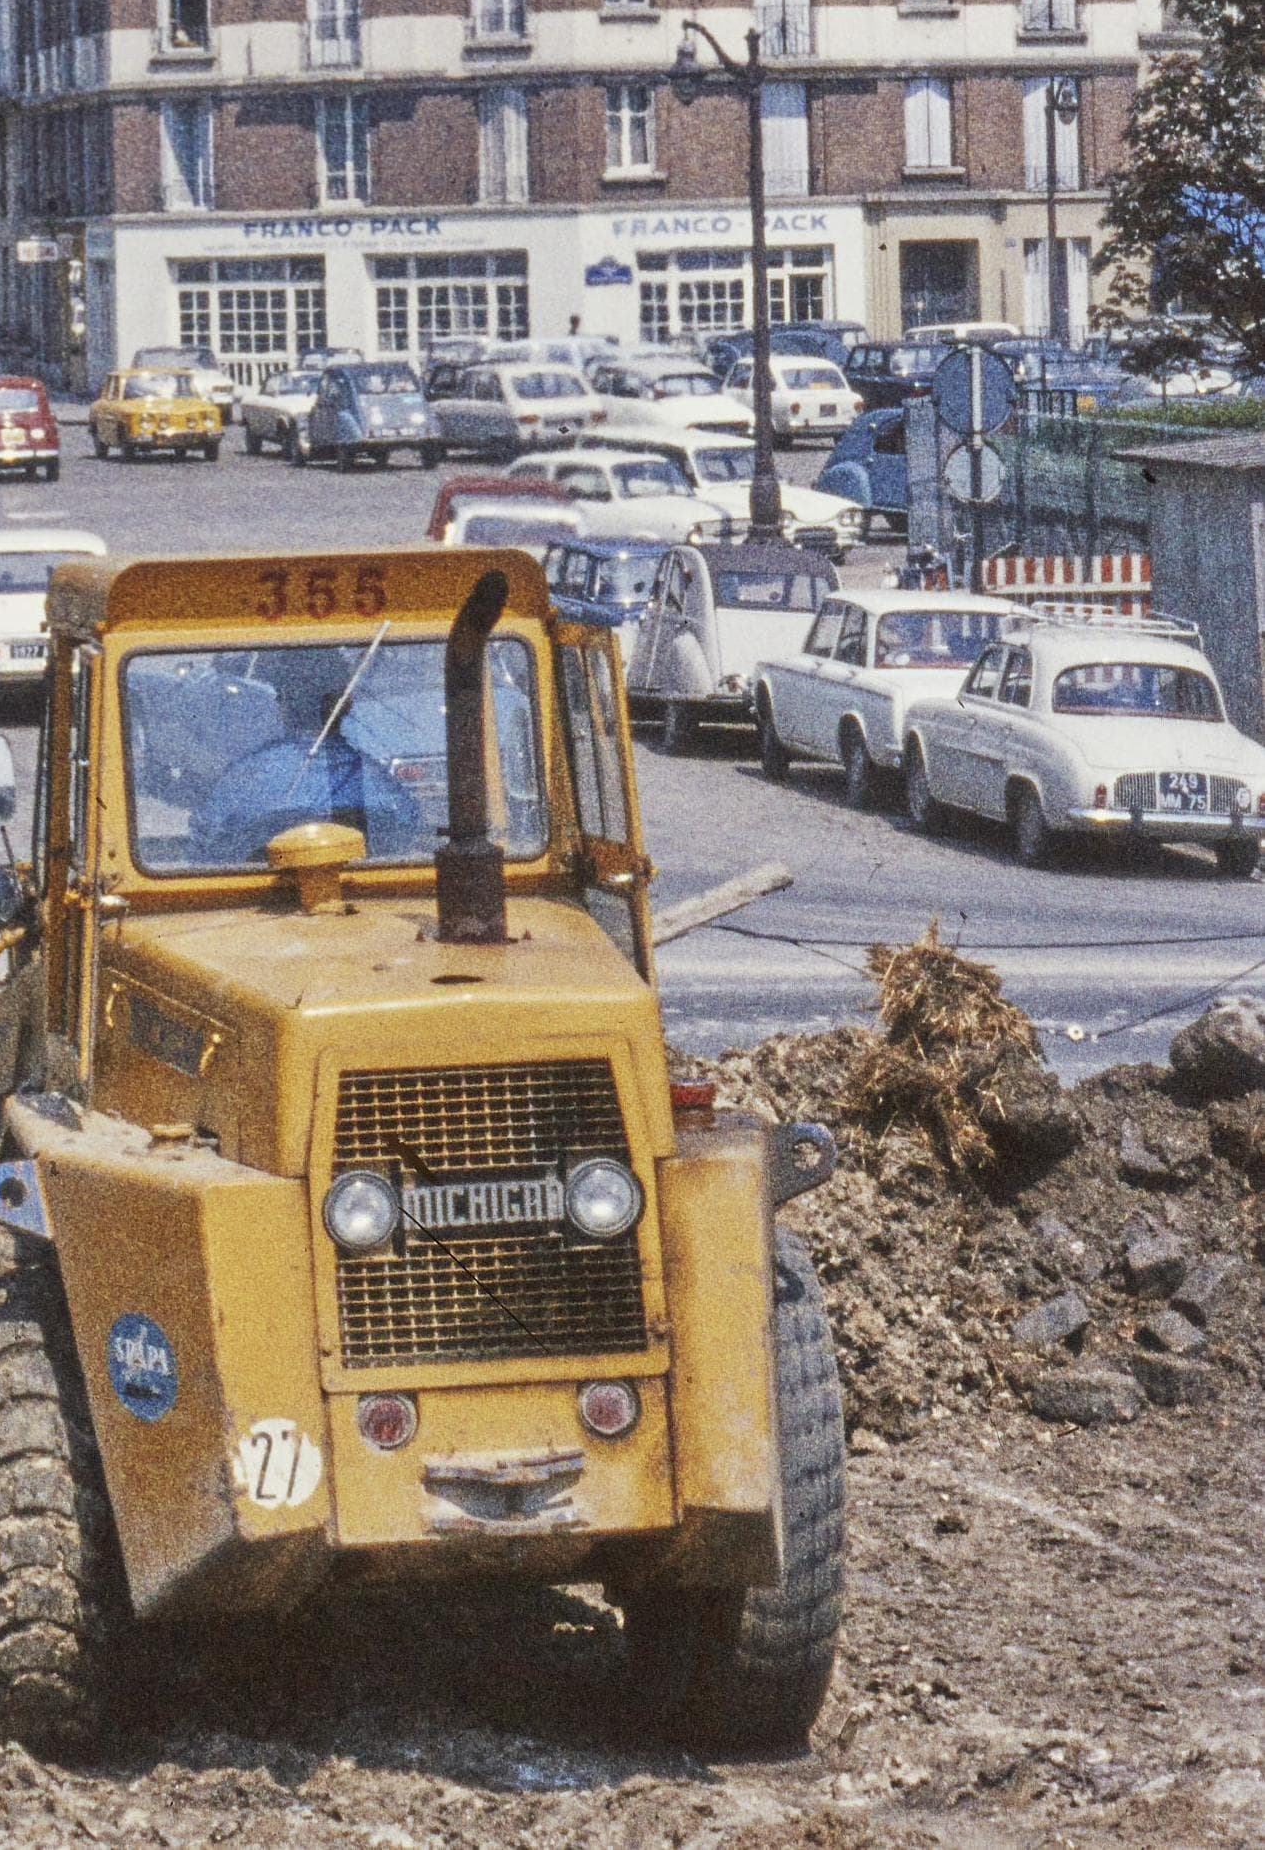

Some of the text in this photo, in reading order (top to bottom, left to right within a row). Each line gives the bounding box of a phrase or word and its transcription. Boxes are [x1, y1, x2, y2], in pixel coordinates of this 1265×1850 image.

[243, 219, 352, 238] FRANCO
[370, 217, 442, 235] PACK
[612, 217, 732, 237] FRANCO
[763, 214, 829, 232] ACK
[1189, 794, 1207, 810] 75
[250, 1430, 303, 1500] 27
